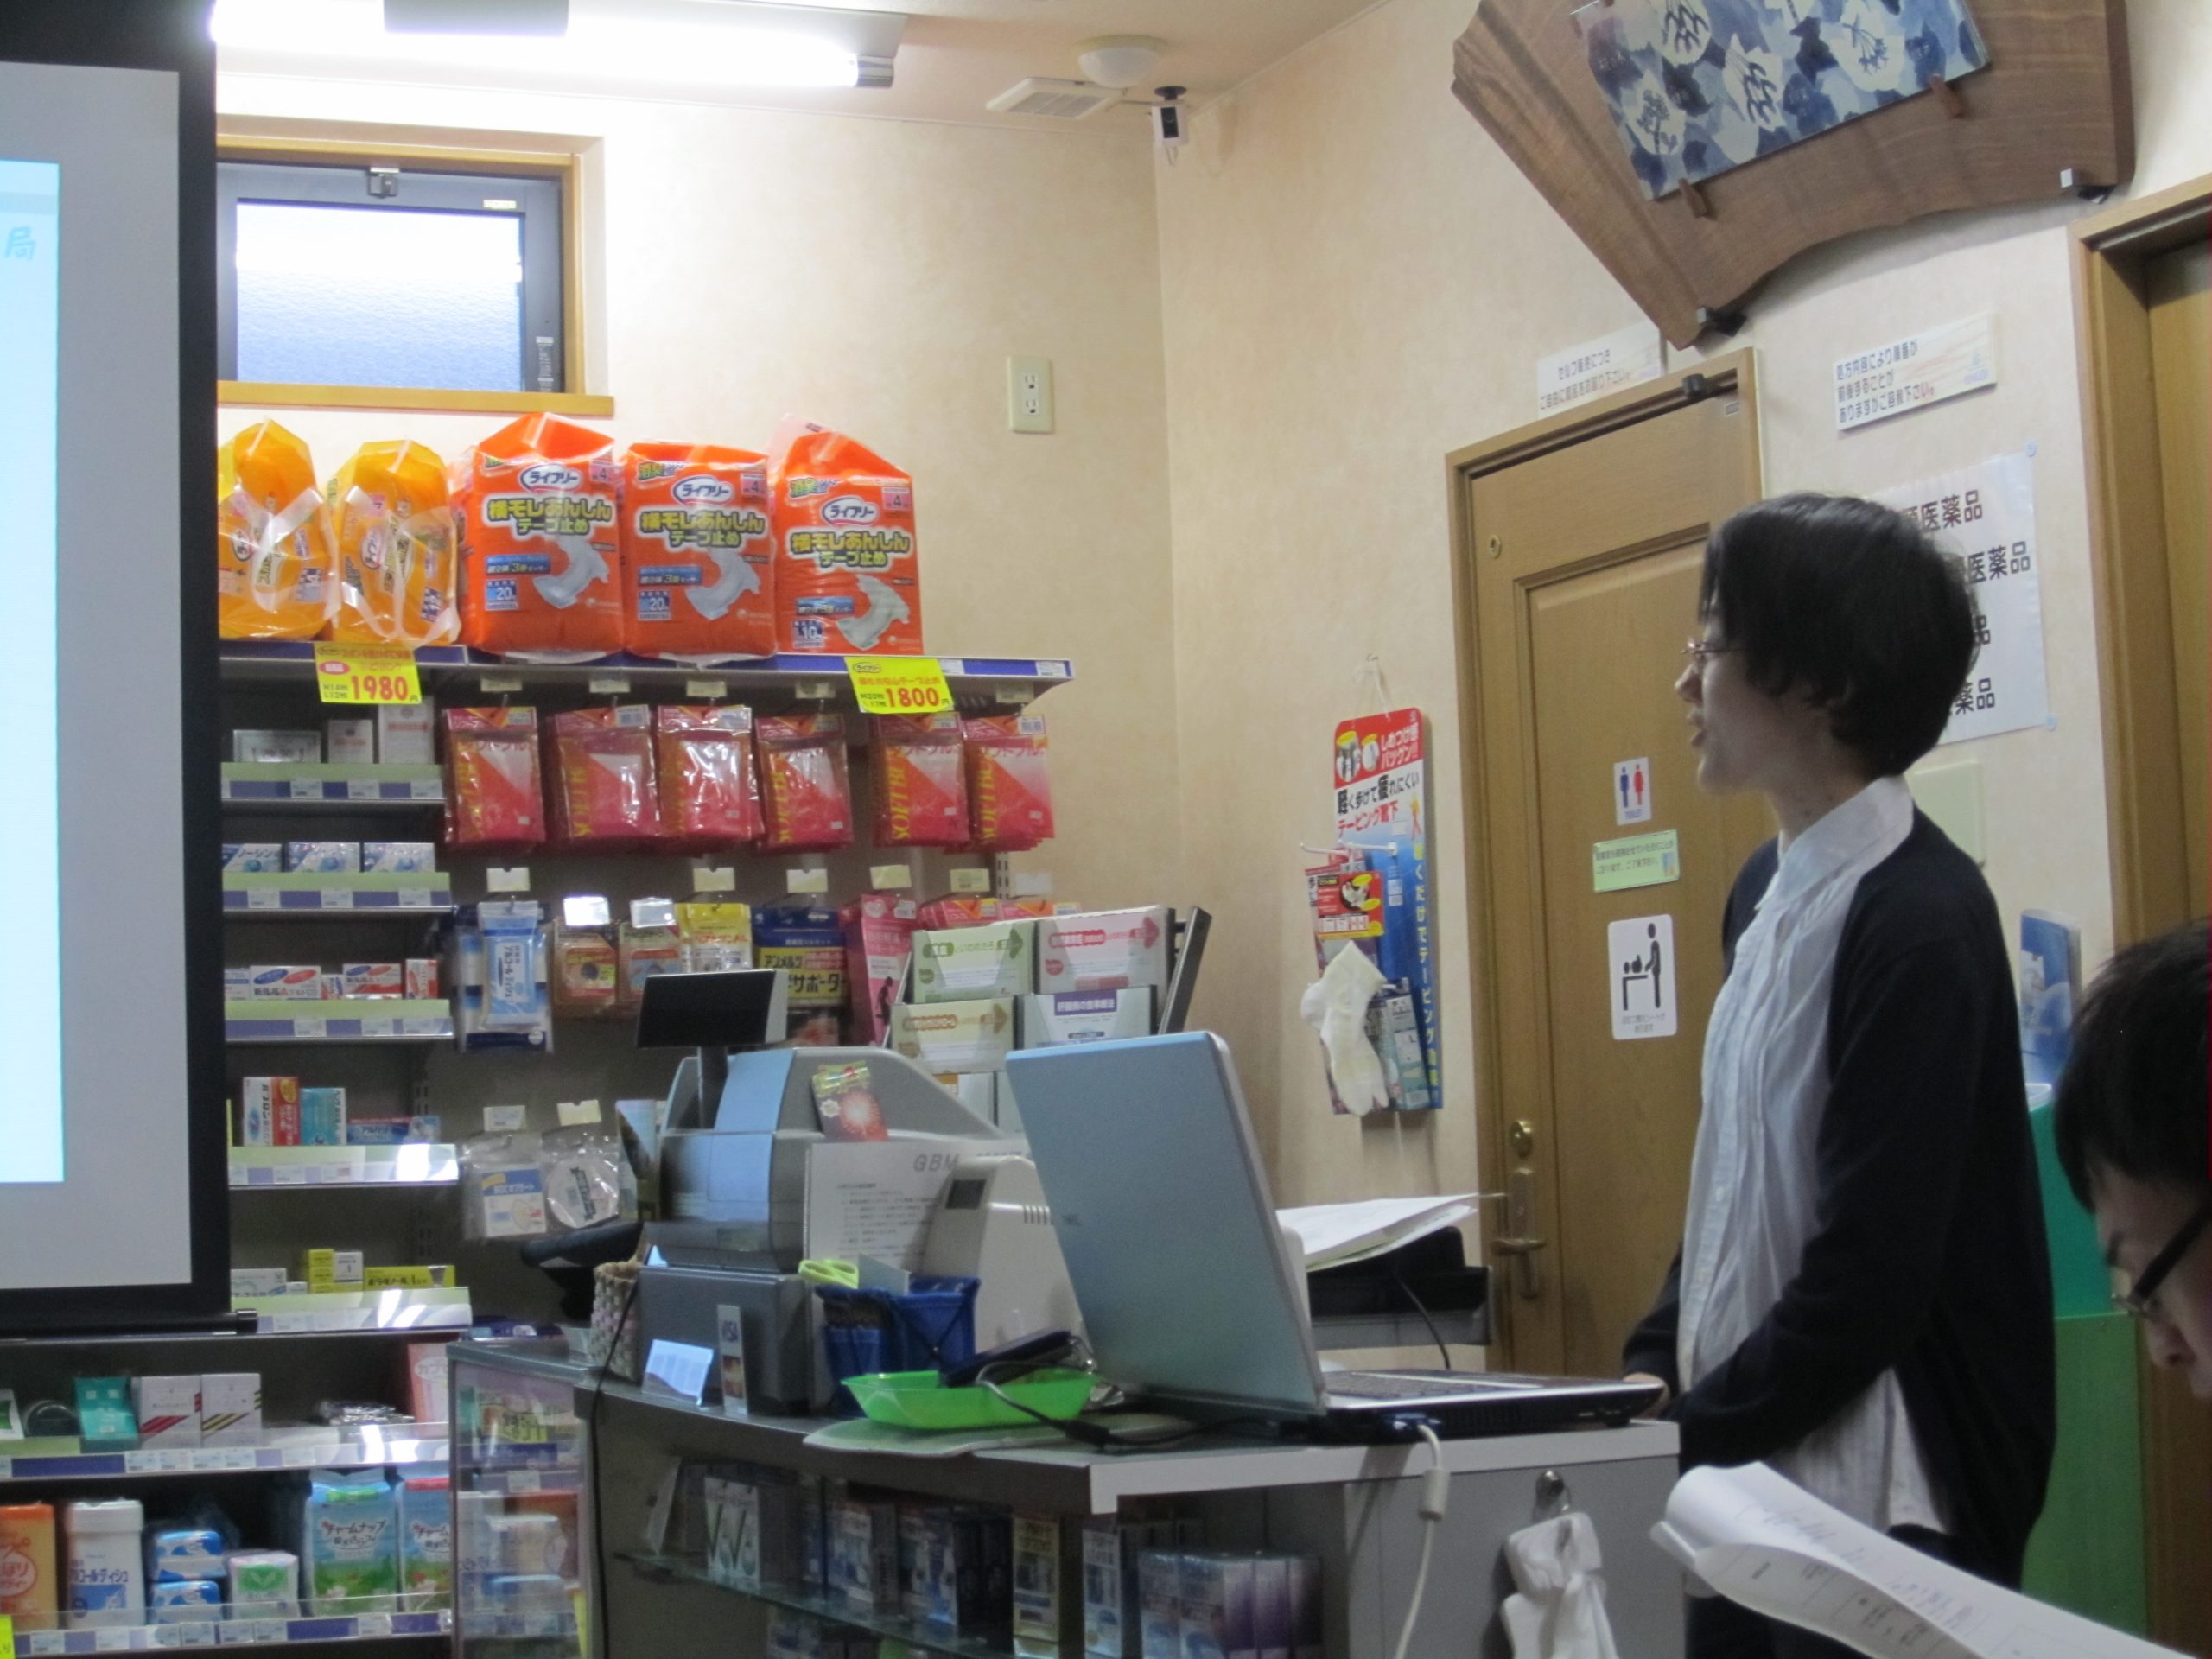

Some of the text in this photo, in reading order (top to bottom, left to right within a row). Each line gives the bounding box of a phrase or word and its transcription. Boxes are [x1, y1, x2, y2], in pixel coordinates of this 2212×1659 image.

[3, 226, 36, 260] 局
[530, 470, 579, 484] ライフリー
[682, 484, 729, 498] ライフリー
[488, 497, 613, 522] 横モレあんしん
[830, 505, 875, 518] ライフリー
[640, 511, 765, 534] 横モレあんしん
[791, 531, 910, 554] 横モレあんしん
[351, 675, 409, 701] 1980
[886, 687, 939, 708] 1800
